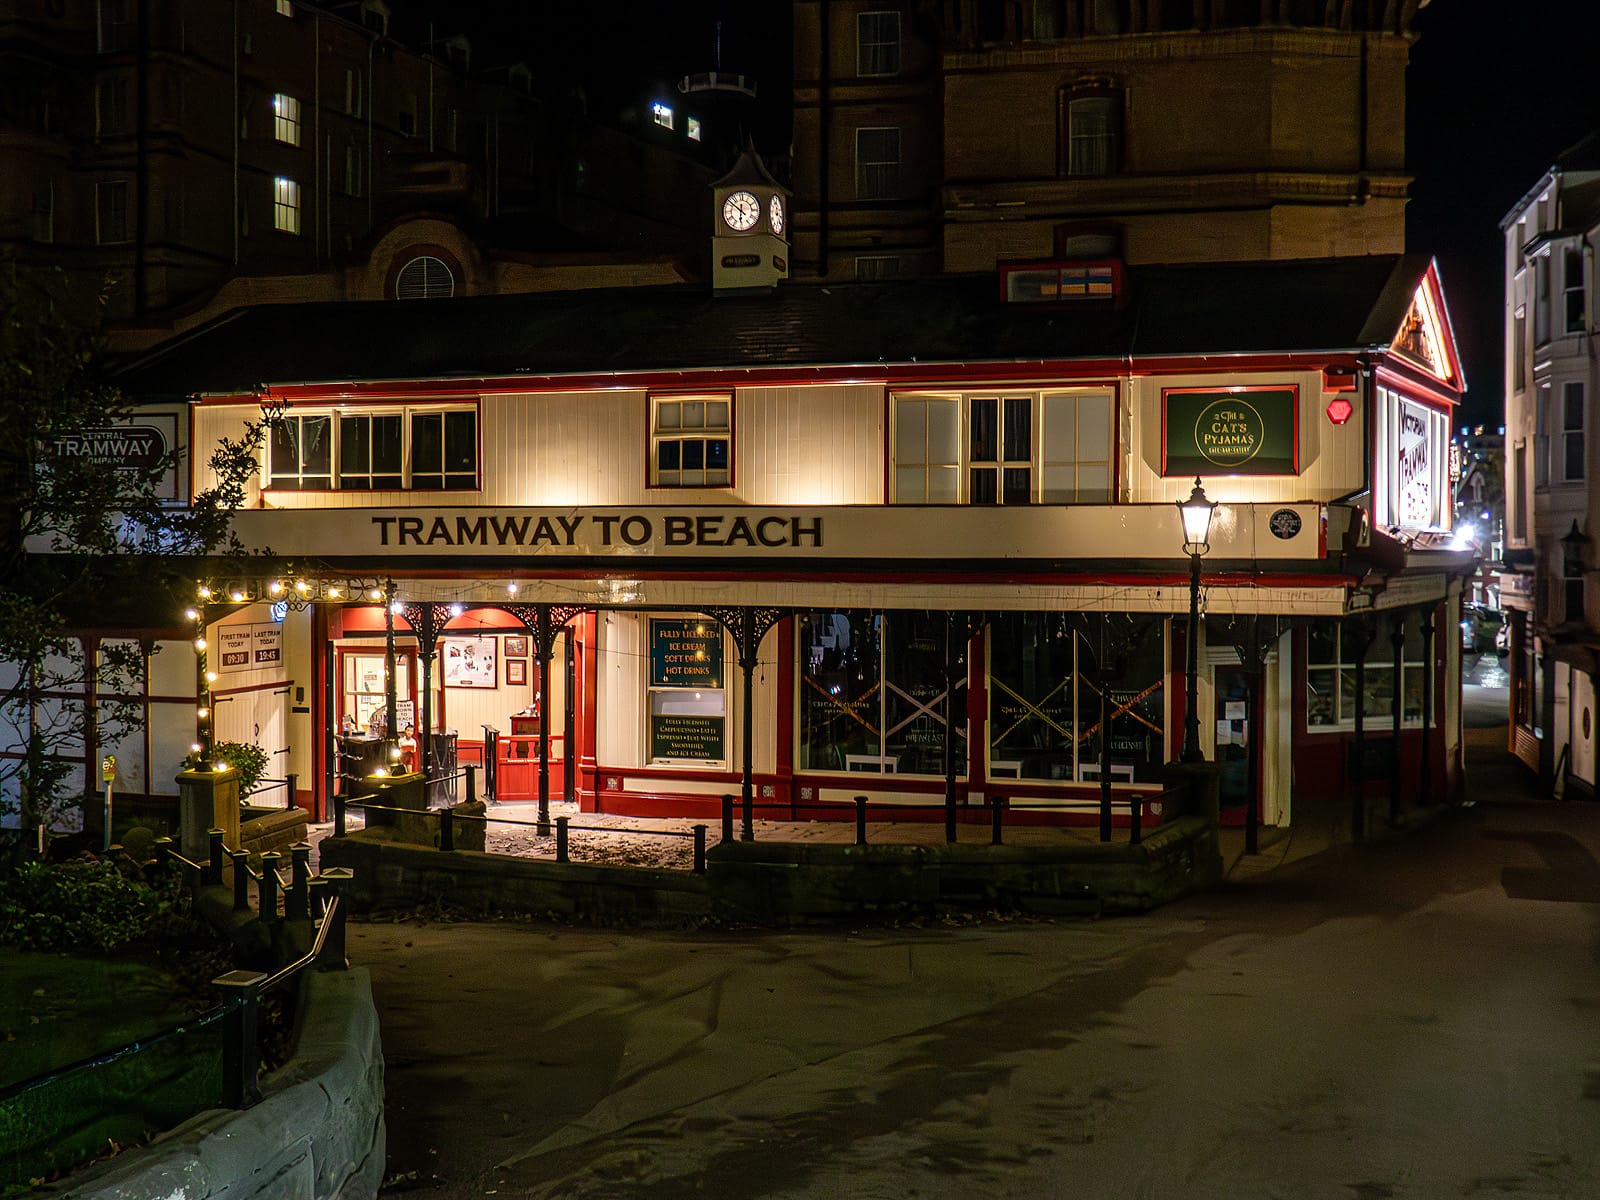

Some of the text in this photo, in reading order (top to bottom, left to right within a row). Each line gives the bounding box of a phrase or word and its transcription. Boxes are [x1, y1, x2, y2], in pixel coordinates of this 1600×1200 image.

[1212, 423, 1247, 433] CAT'S
[1204, 434, 1254, 446] PYJAMAS
[54, 440, 153, 456] TRAMWAY
[371, 515, 823, 547] TRAMWAY TO BEACH
[660, 630, 680, 638] FULLY
[682, 643, 706, 651] CREAM
[684, 667, 710, 675] DRINKS
